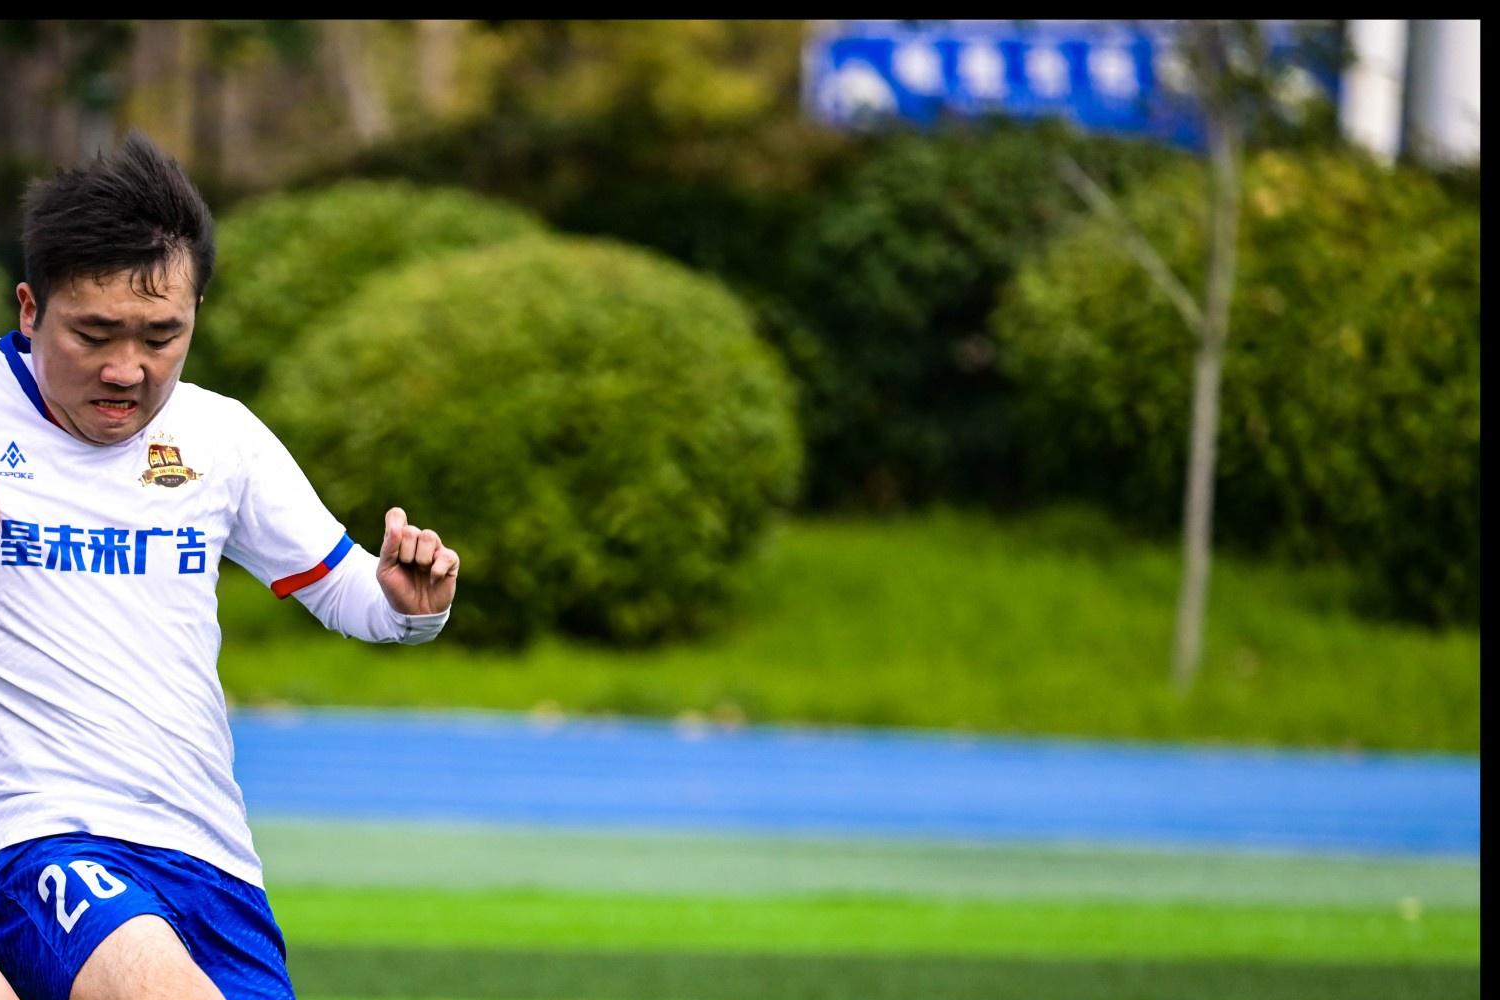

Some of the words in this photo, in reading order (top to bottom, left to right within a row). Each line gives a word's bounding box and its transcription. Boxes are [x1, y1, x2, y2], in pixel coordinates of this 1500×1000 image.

[0, 519, 206, 575] 星未来广告
